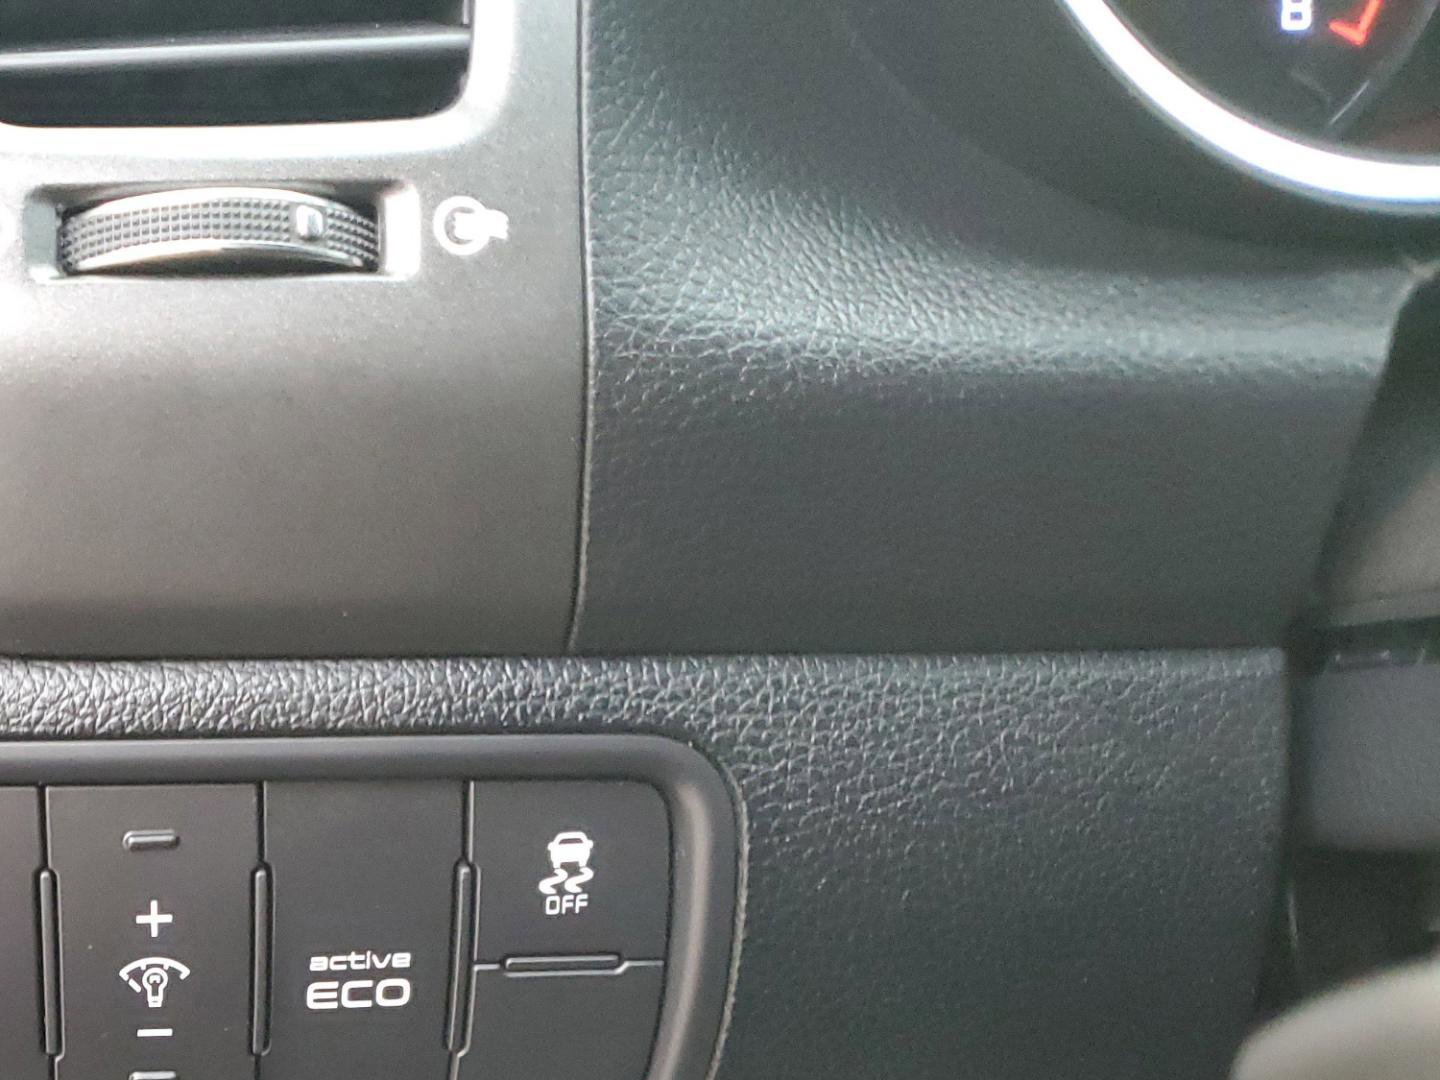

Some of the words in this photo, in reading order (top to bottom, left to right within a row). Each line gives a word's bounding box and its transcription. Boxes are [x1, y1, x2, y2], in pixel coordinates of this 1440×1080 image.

[545, 893, 589, 915] OFF
[309, 950, 411, 972] active
[306, 978, 411, 1010] ECO
